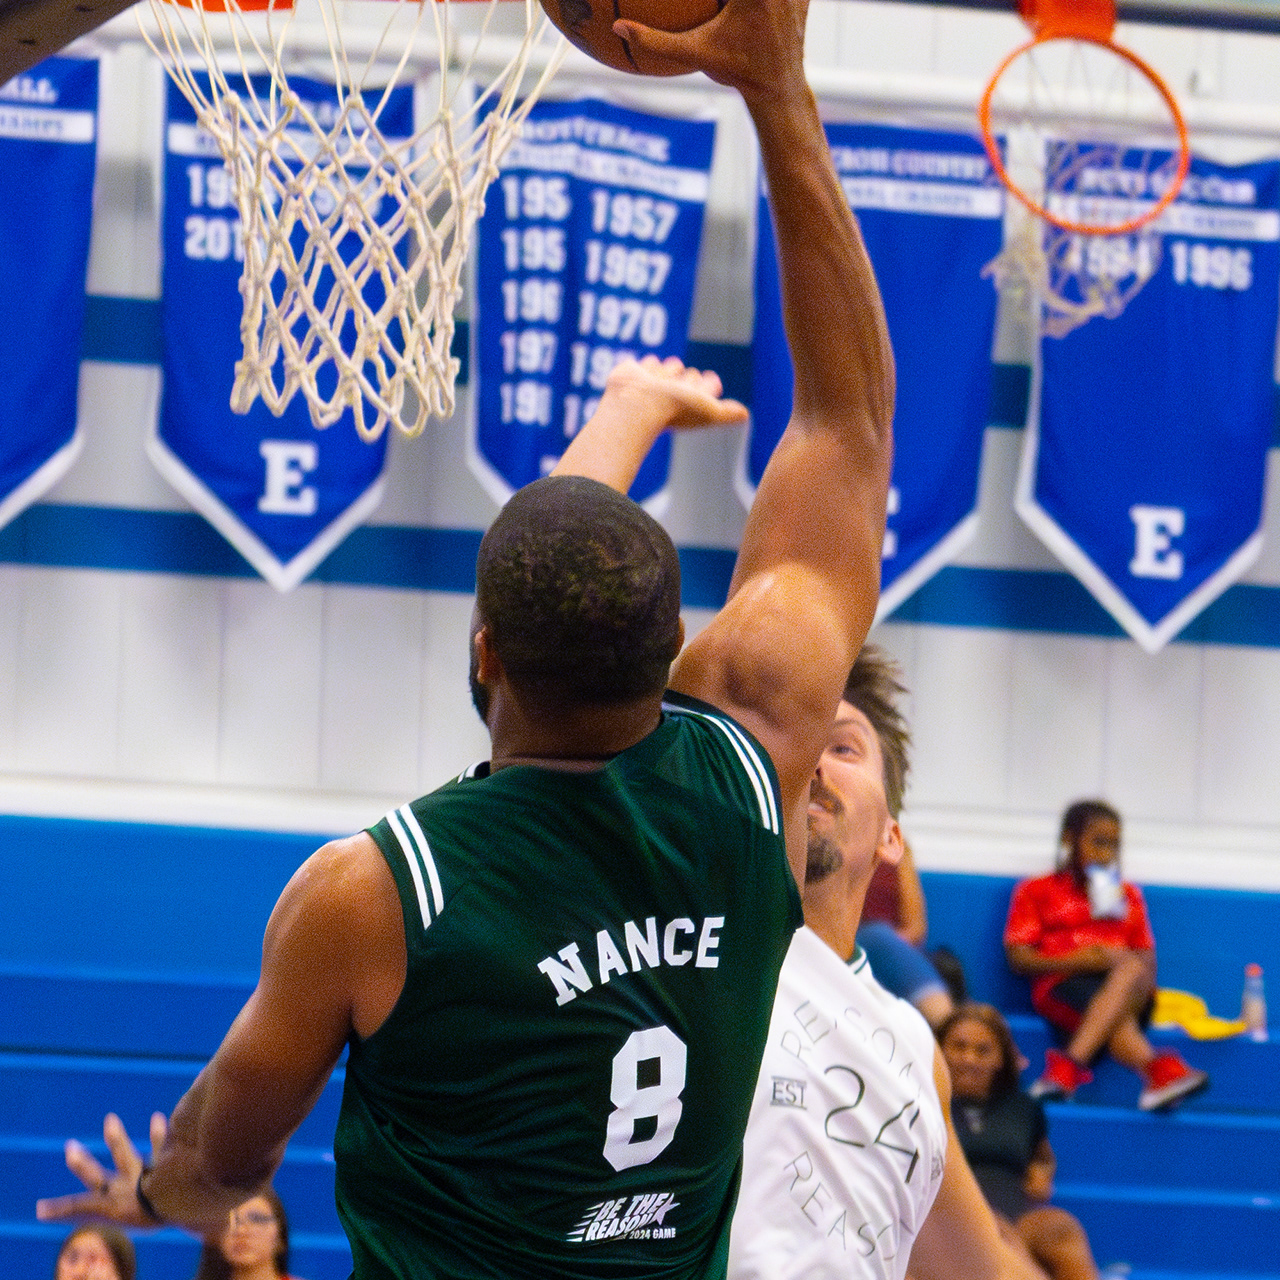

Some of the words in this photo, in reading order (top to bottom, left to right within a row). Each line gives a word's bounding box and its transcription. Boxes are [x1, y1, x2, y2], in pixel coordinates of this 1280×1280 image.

[592, 187, 678, 243] 1957
[585, 239, 671, 295] 1967
[1173, 242, 1253, 291] 1996
[578, 289, 668, 348] 1970
[258, 442, 318, 516] E
[1130, 504, 1184, 579] E
[537, 916, 725, 1007] NANCE
[602, 1025, 688, 1172] 8
[772, 1081, 807, 1108] EST
[824, 1064, 919, 1183] 24
[594, 1197, 627, 1221] BE
[624, 1192, 669, 1217] THE
[629, 1229, 651, 1240] 2024
[653, 1227, 676, 1239] GAME
